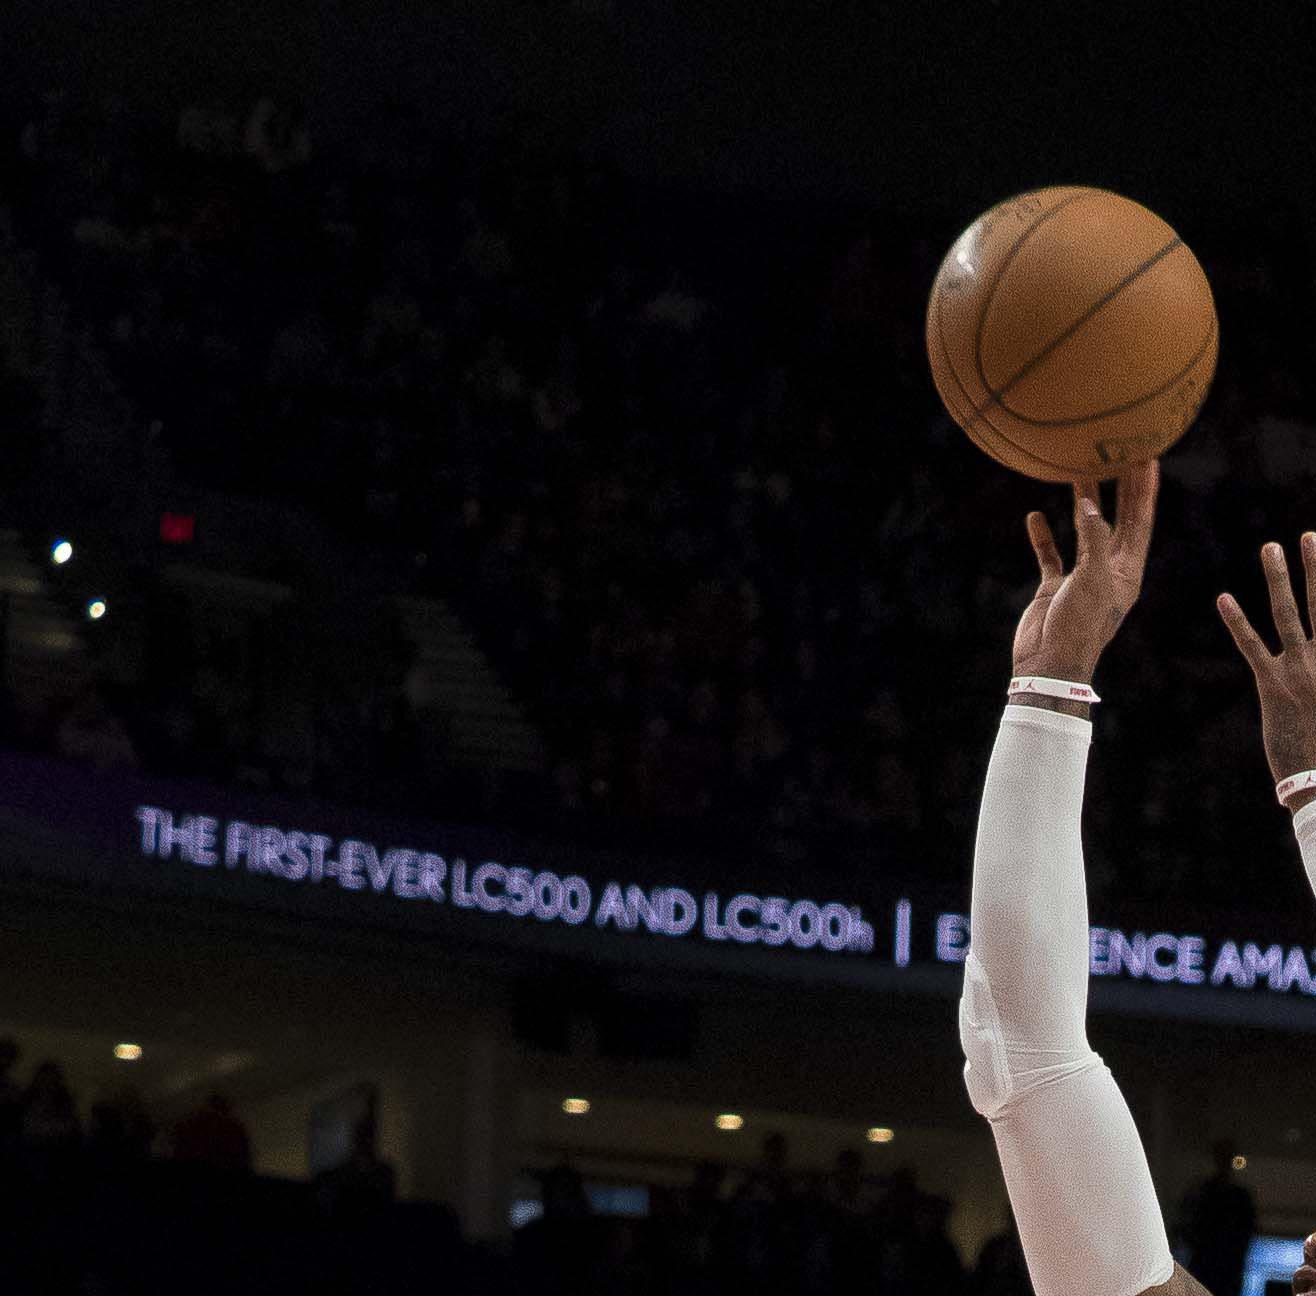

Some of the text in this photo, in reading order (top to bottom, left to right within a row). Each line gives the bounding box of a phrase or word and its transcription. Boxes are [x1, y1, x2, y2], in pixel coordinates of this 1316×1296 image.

[136, 806, 219, 866] THE
[224, 820, 448, 902] FIRST-EVER
[450, 857, 592, 925] LC500
[595, 882, 698, 936] AND
[703, 891, 876, 953] LC500h
[936, 913, 1205, 985] EENCE
